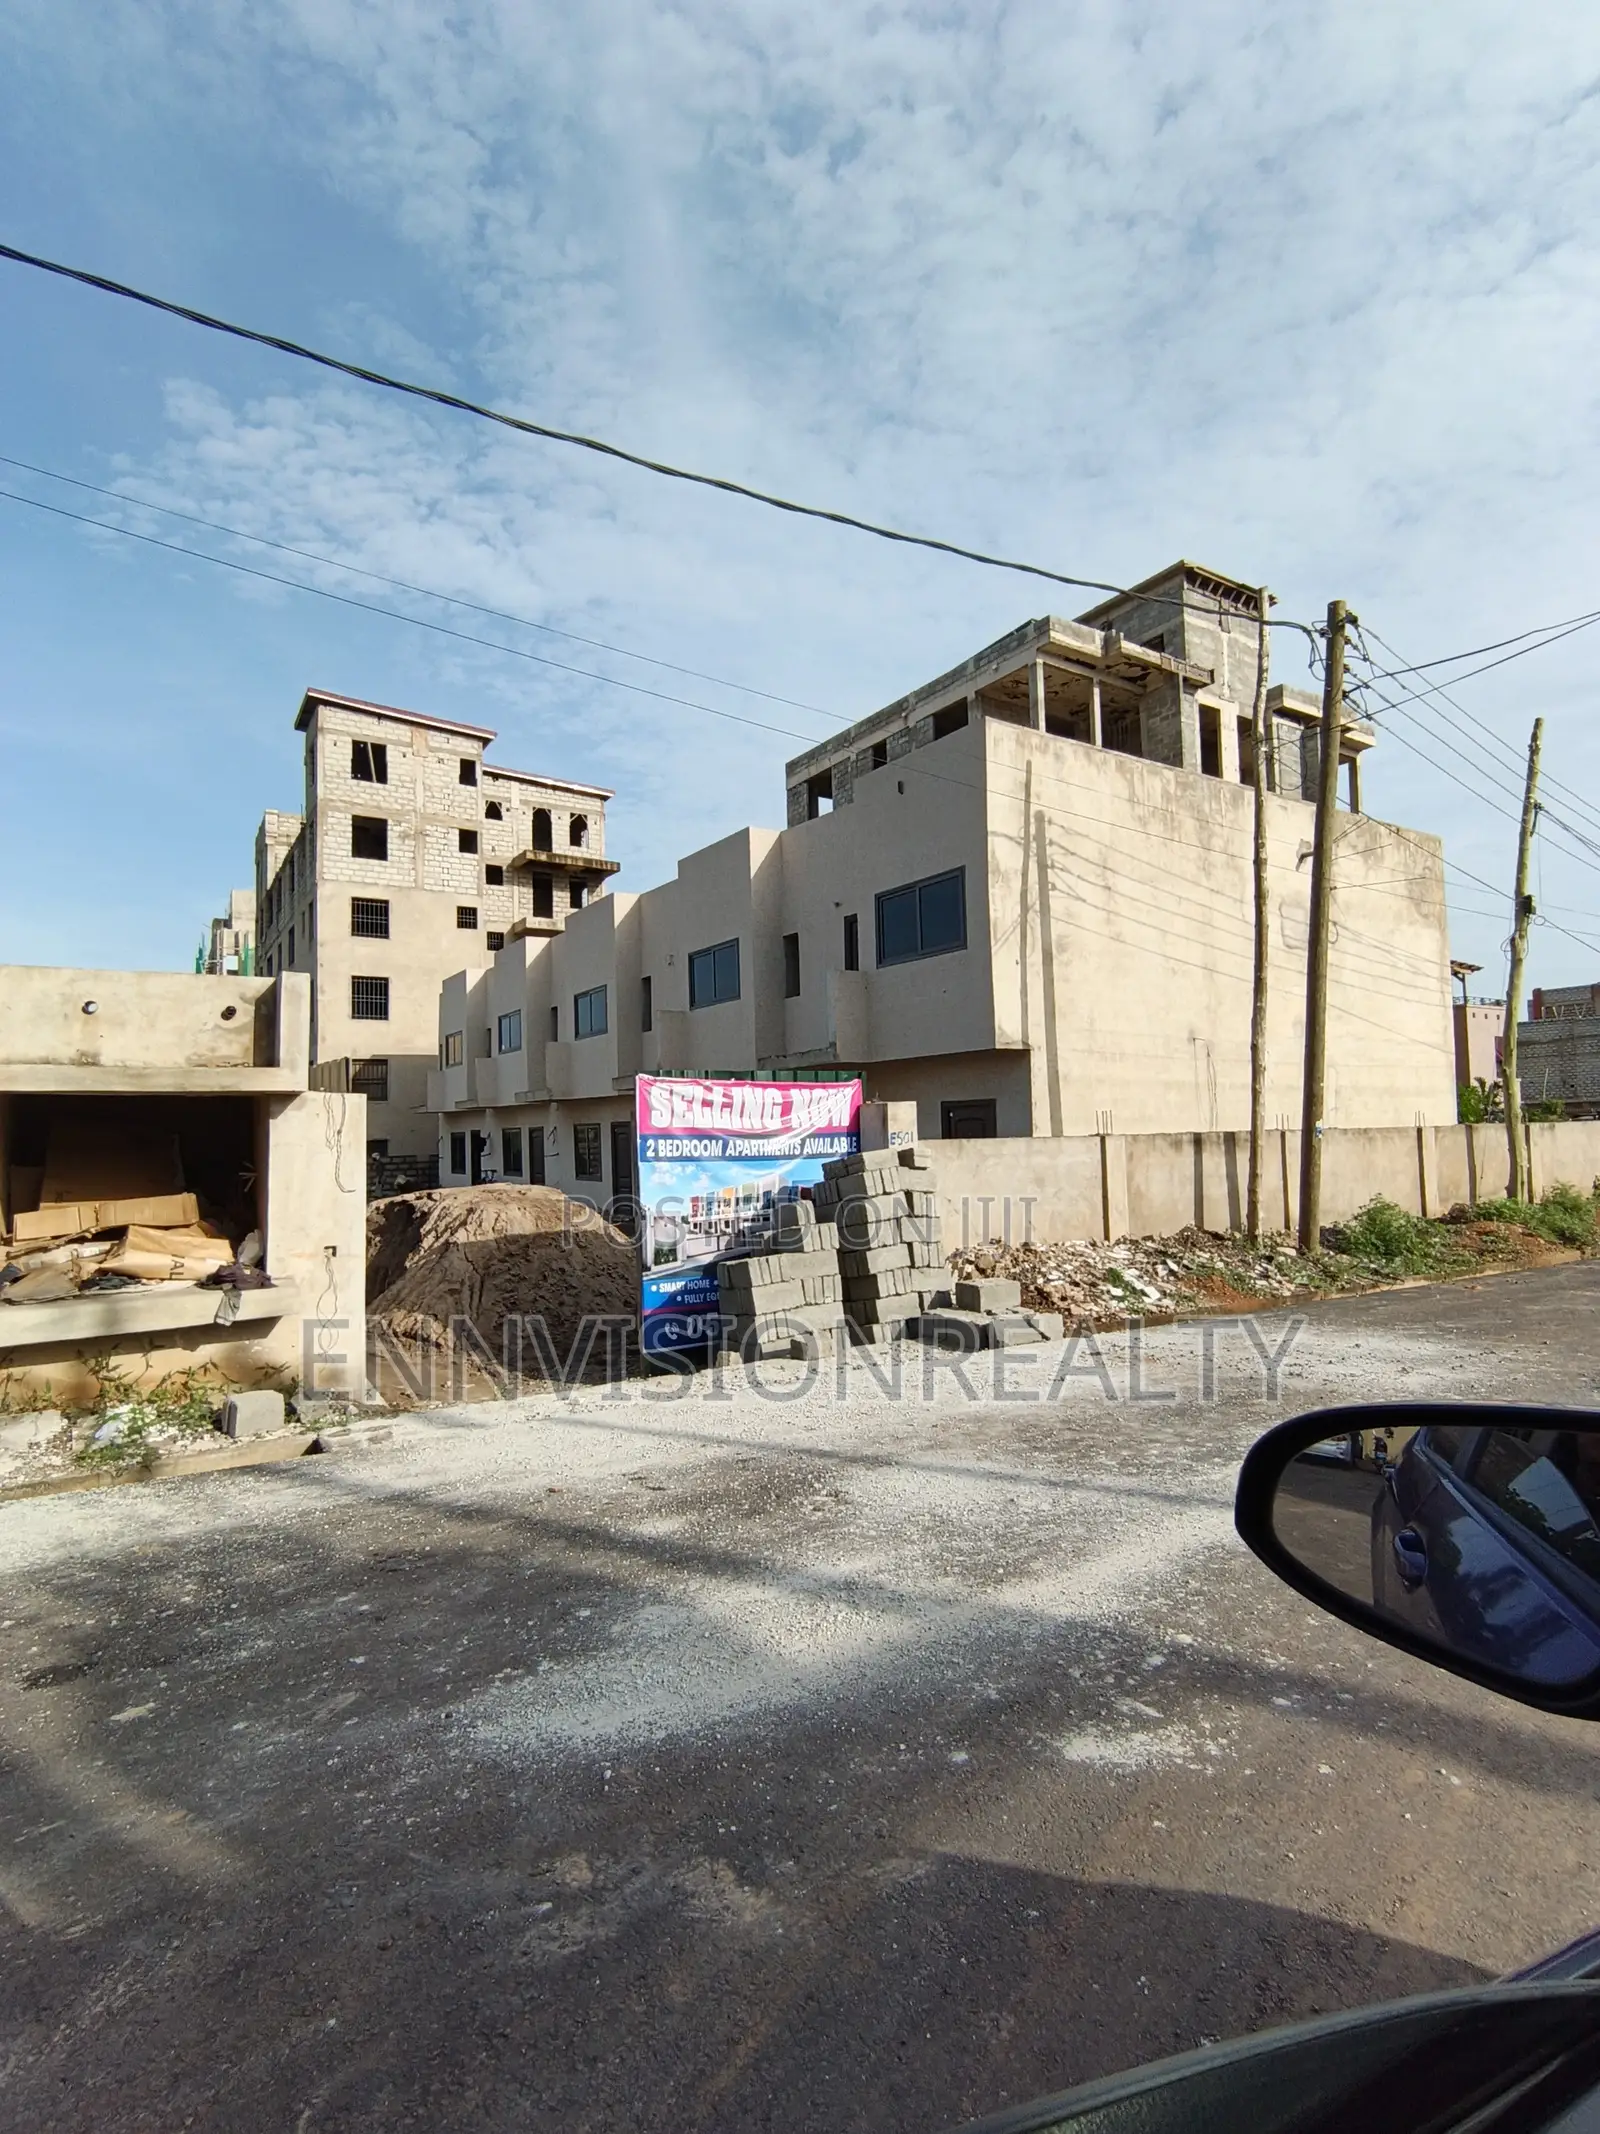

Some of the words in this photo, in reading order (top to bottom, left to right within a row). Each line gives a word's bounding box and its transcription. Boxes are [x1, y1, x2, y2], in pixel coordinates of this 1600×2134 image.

[650, 1084, 783, 1130] SELLING
[790, 1087, 853, 1129] NOW
[646, 1138, 656, 1157] 2
[658, 1138, 723, 1157] BEDROOM
[725, 1138, 802, 1157] APARTMENTS
[803, 1136, 857, 1156] AVAILABLE
[659, 1281, 686, 1293] SMART
[687, 1279, 710, 1290] HOME
[684, 1293, 705, 1304] FULLY
